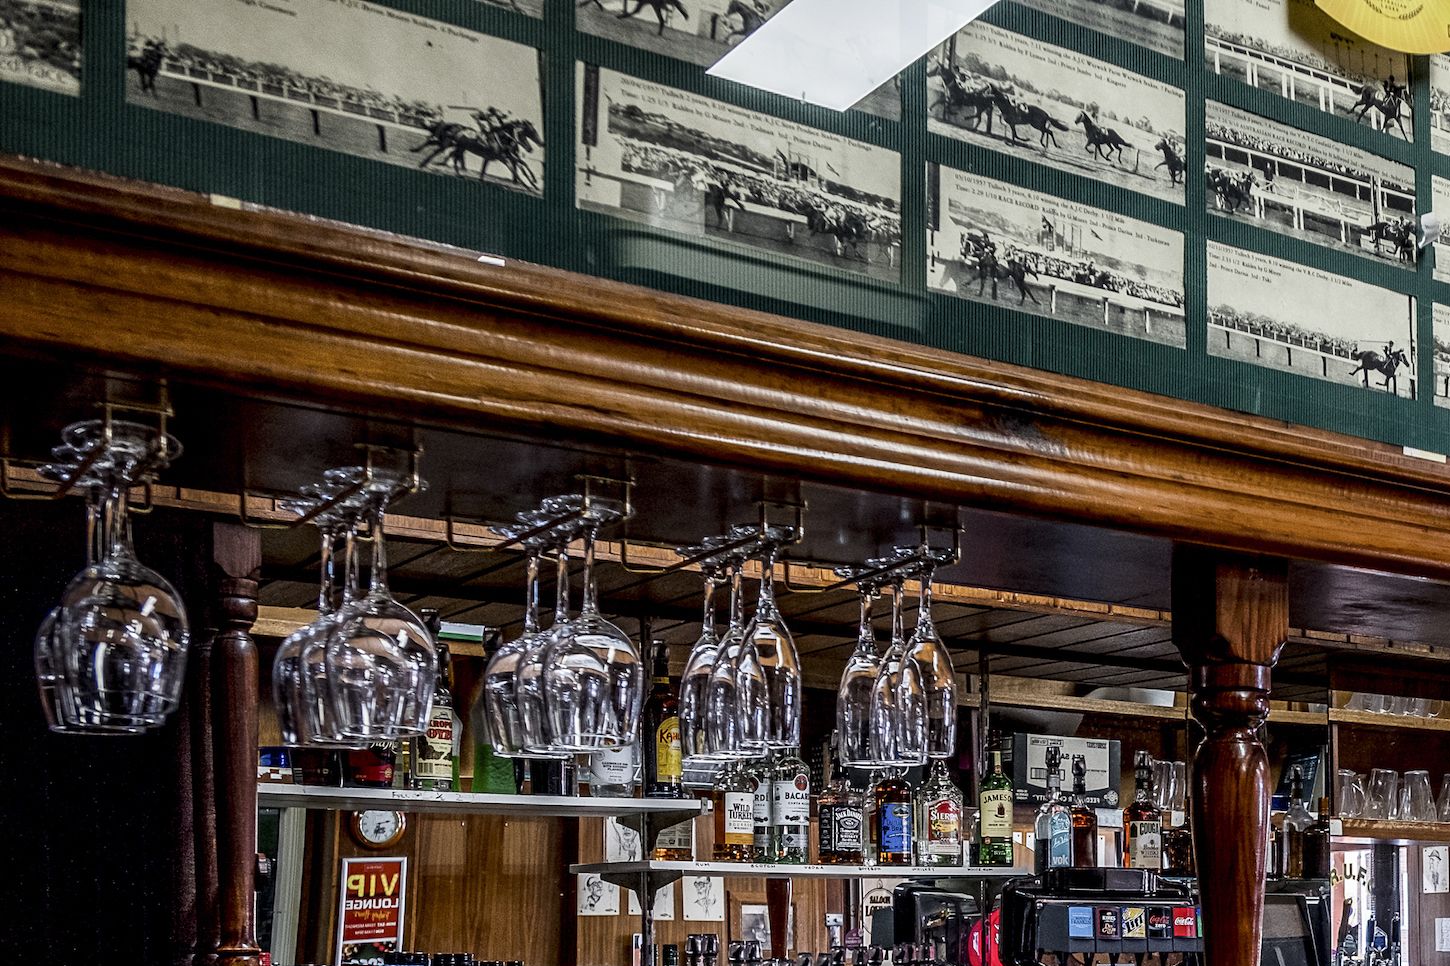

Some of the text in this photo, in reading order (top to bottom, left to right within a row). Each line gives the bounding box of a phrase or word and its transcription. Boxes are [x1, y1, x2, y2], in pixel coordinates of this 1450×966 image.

[983, 794, 1013, 804] JAMESO
[732, 803, 751, 812] WILD
[1140, 822, 1160, 835] COUGA
[1052, 856, 1069, 865] vok
[1174, 917, 1194, 926] Coca-Cola
